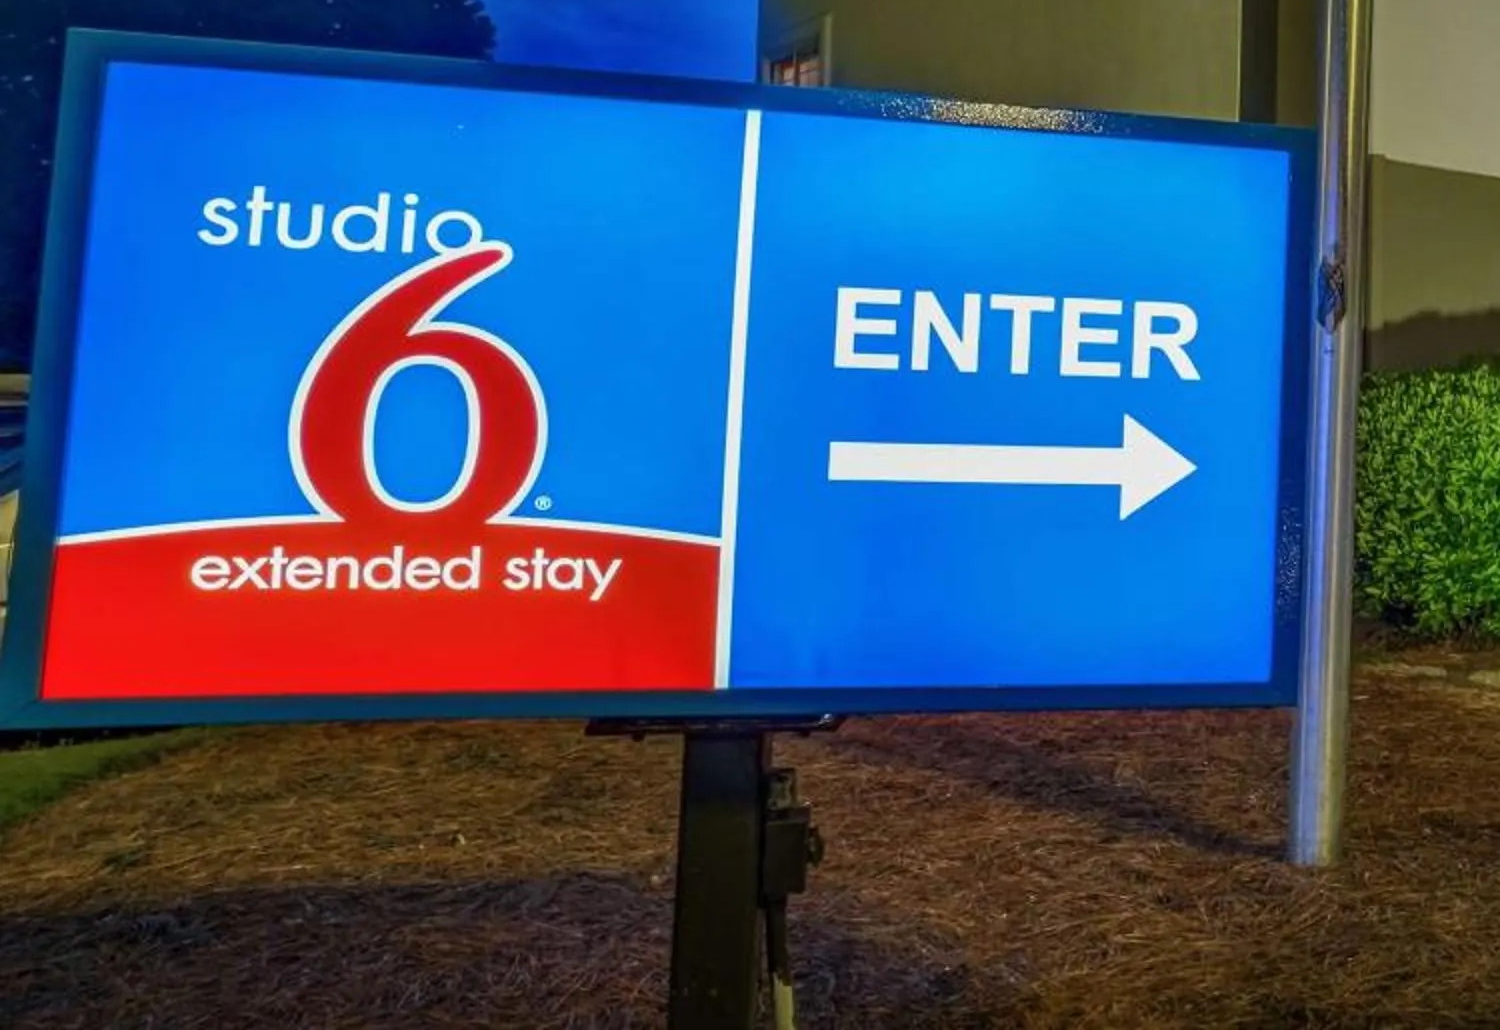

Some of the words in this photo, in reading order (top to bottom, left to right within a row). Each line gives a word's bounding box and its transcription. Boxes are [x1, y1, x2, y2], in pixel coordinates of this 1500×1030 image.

[197, 186, 483, 256] studio
[833, 286, 1201, 381] ENTER
[289, 240, 549, 524] 6
[190, 545, 481, 592] extended
[502, 550, 623, 601] stay
